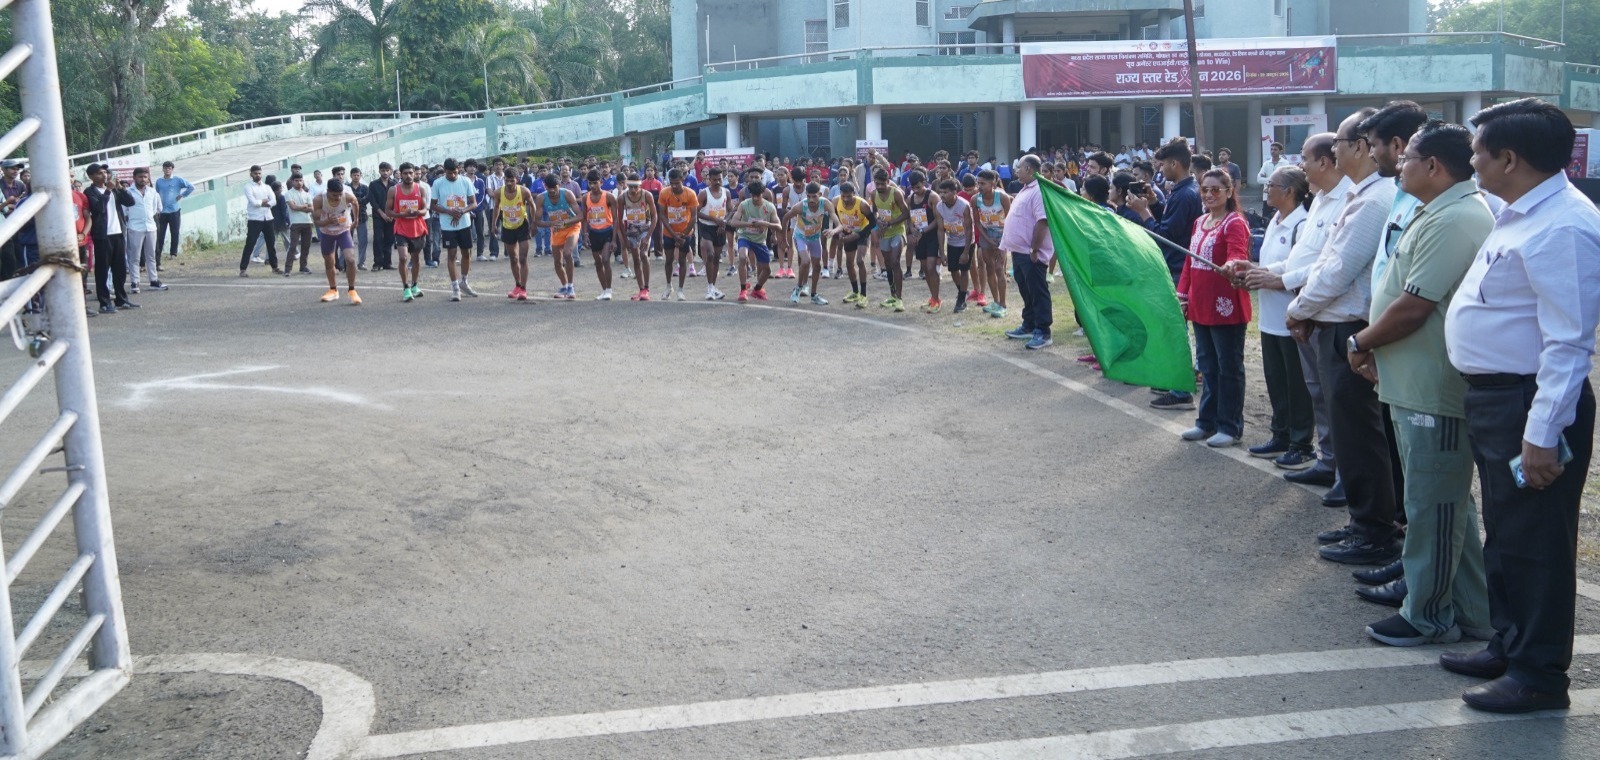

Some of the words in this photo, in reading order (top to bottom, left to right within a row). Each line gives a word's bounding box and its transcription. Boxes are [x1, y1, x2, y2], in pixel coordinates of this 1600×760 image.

[1115, 73, 1139, 83] राज्य
[1142, 72, 1163, 83] स्तर
[1164, 68, 1178, 82] रेड
[1210, 70, 1242, 81] 2026
